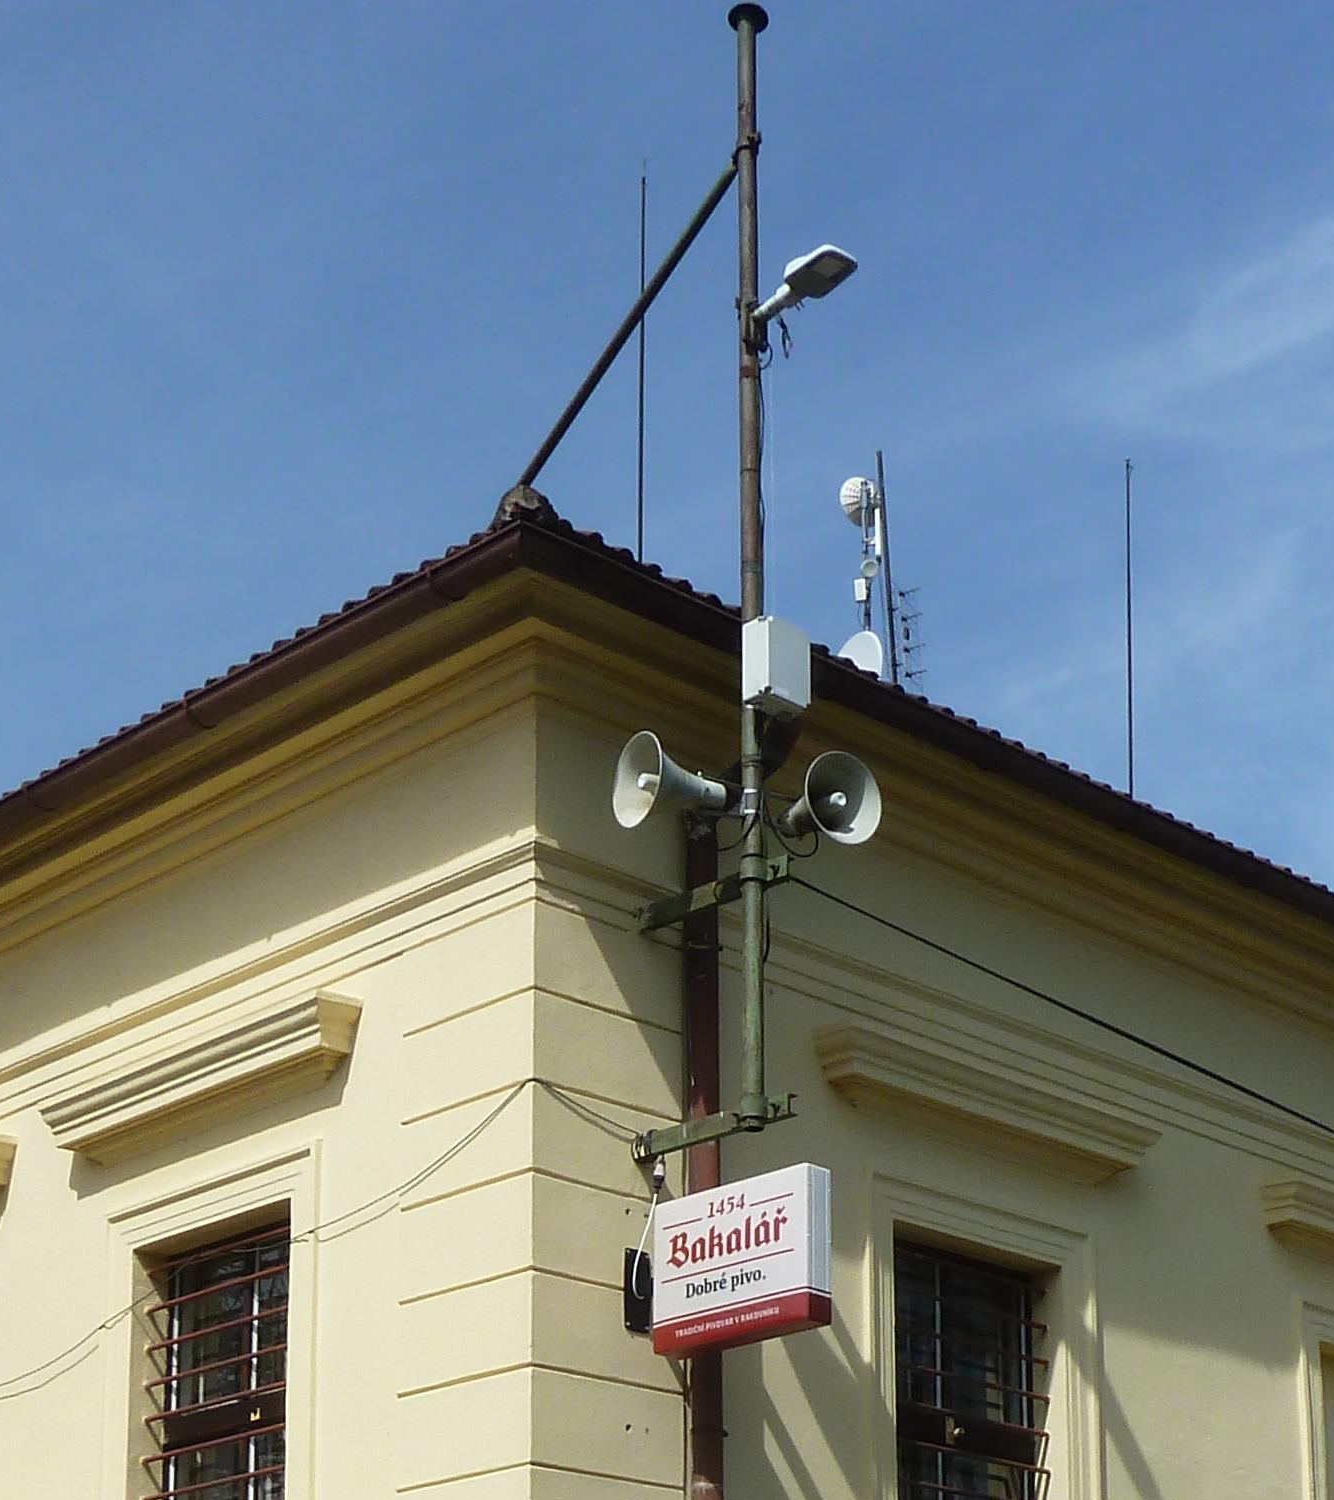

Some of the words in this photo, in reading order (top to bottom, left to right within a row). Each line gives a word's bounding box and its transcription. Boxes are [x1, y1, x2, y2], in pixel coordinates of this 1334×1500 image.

[707, 1193, 746, 1219] 1454
[666, 1205, 788, 1269] Bakalář
[685, 1272, 727, 1299] Dobré
[730, 1266, 767, 1292] pivo.
[674, 1323, 706, 1338] TRADIČNÍ
[706, 1316, 734, 1332] PIVOVAR
[735, 1315, 740, 1324] V
